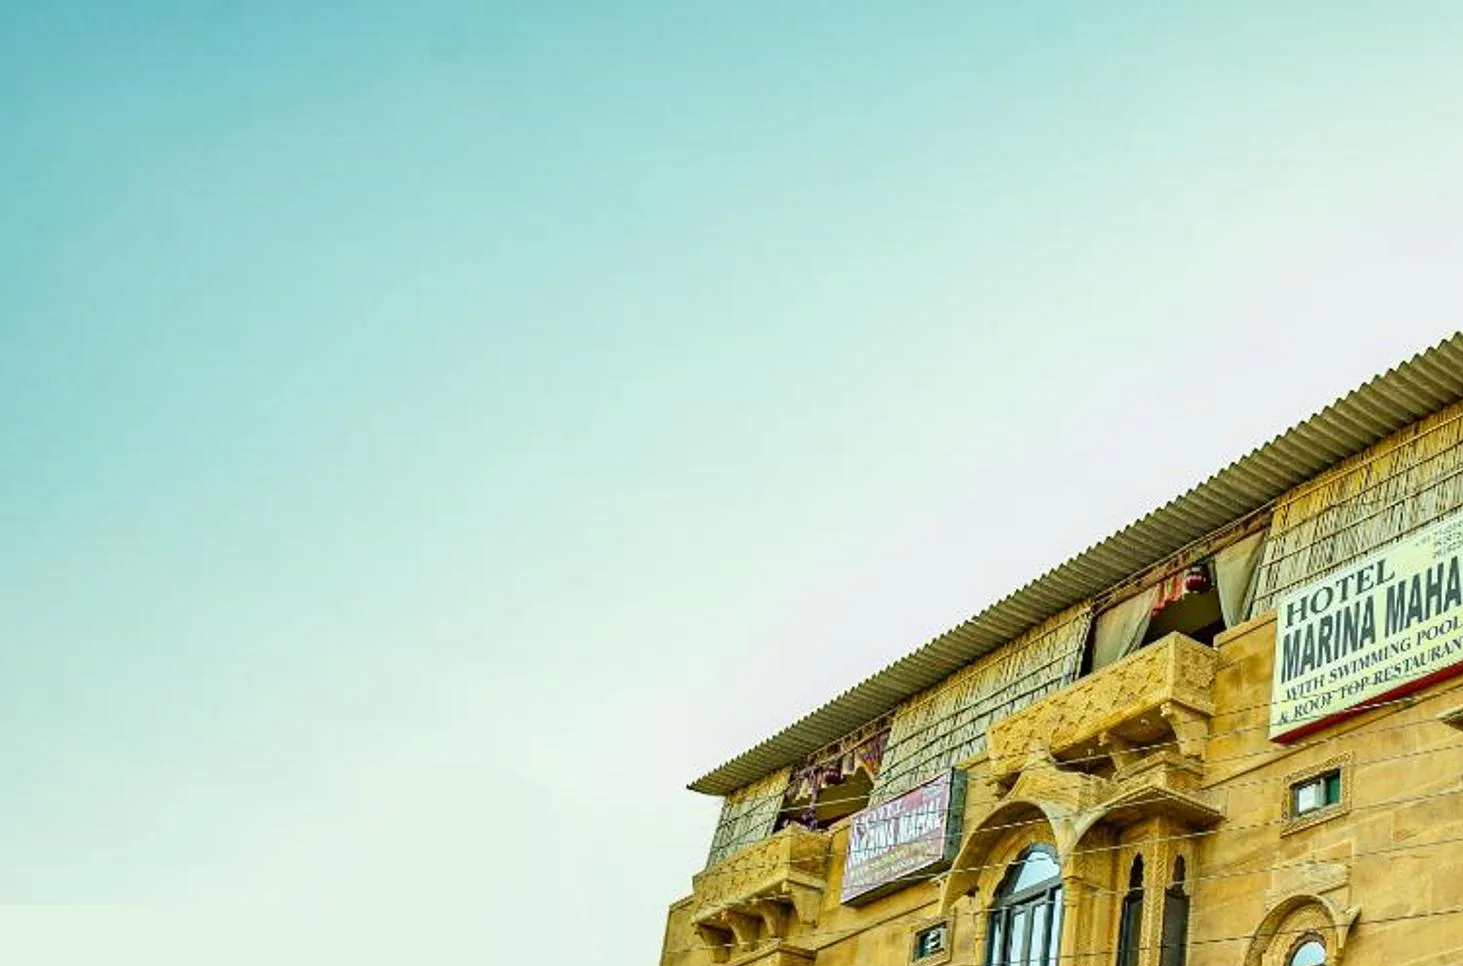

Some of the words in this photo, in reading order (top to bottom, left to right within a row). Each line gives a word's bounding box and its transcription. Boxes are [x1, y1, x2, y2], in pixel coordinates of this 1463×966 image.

[1285, 558, 1396, 629] HOTEL
[1280, 595, 1376, 684] MARINA
[1285, 677, 1325, 702] WITH
[1328, 637, 1412, 684] SWIMMING
[1293, 691, 1333, 720] ROOF
[1336, 677, 1370, 701] TOP
